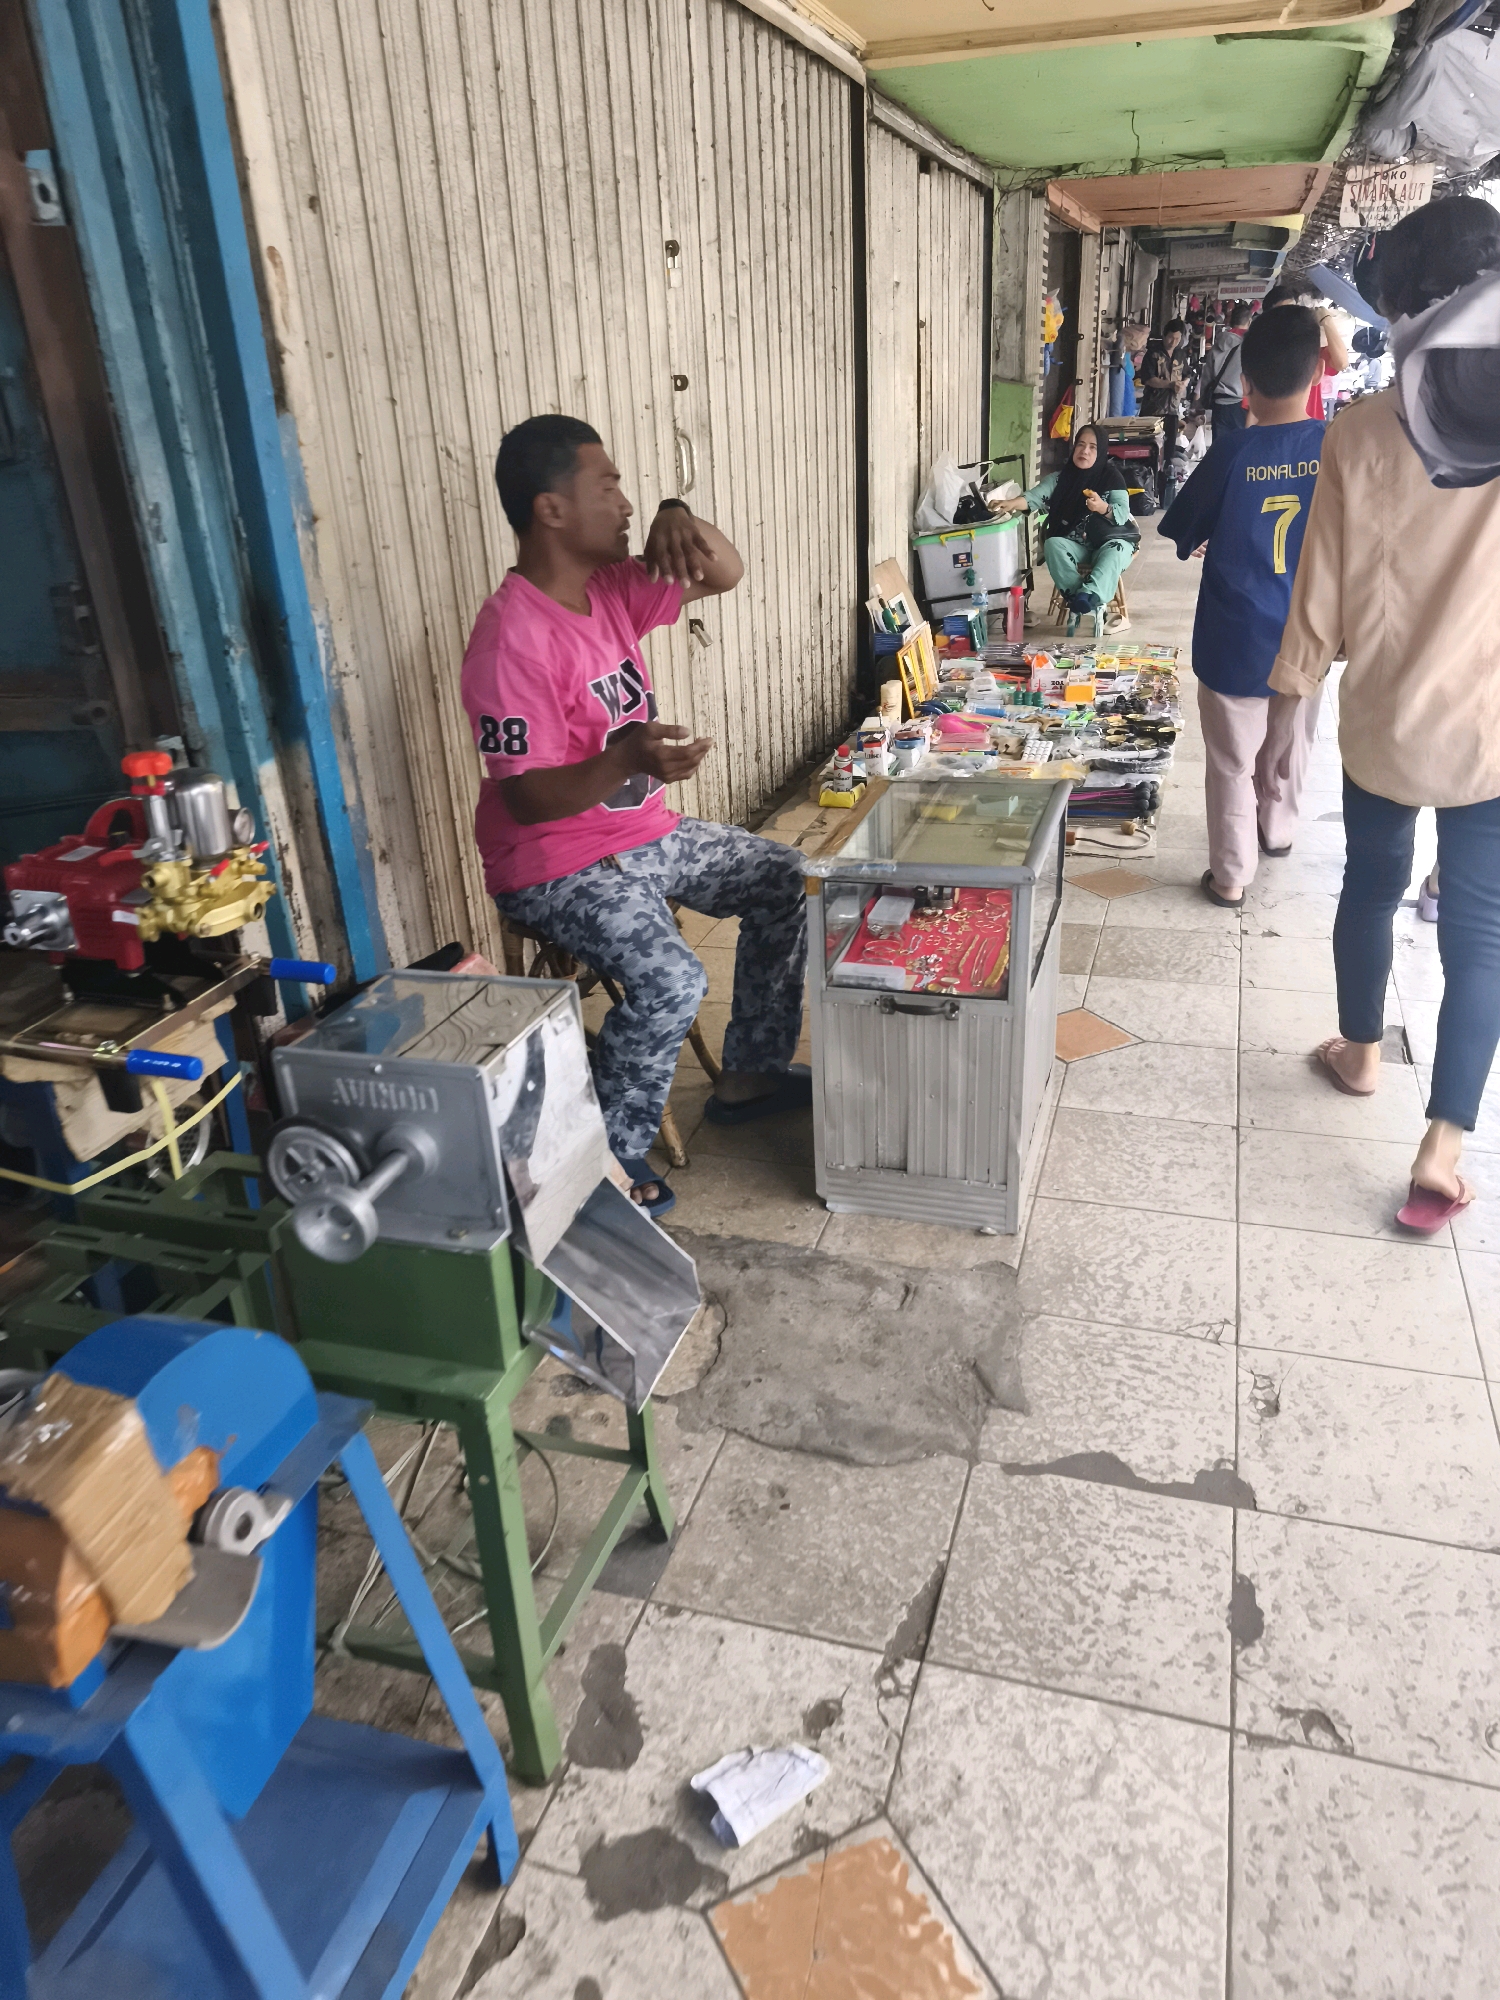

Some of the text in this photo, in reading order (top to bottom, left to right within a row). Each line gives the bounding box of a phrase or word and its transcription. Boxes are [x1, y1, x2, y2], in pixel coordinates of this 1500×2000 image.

[1373, 170, 1407, 181] TOKO
[1246, 459, 1320, 482] RONALDO
[1260, 494, 1302, 574] 7
[478, 714, 530, 756] 88
